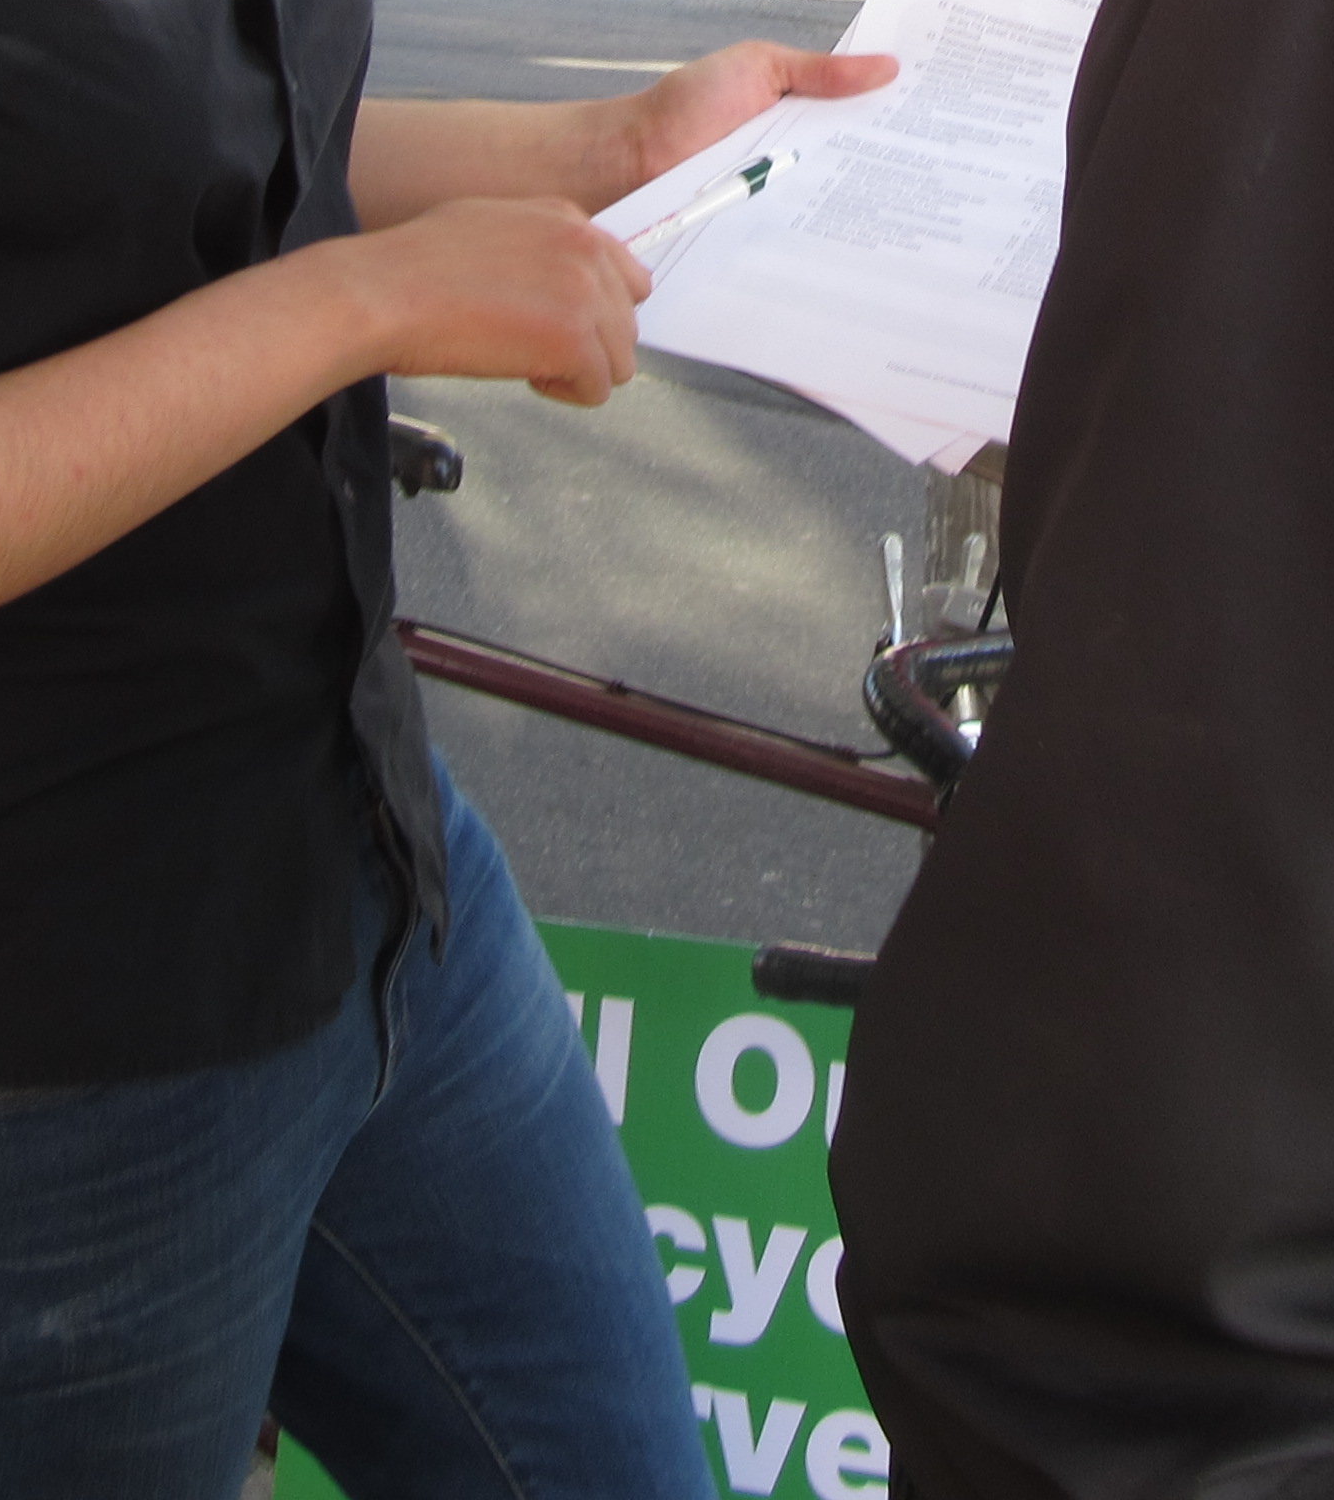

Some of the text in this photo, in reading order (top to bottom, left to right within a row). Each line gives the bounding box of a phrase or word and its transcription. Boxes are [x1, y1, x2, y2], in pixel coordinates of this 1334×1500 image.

[566, 991, 847, 1150] l O
[691, 1382, 891, 1500] ve
